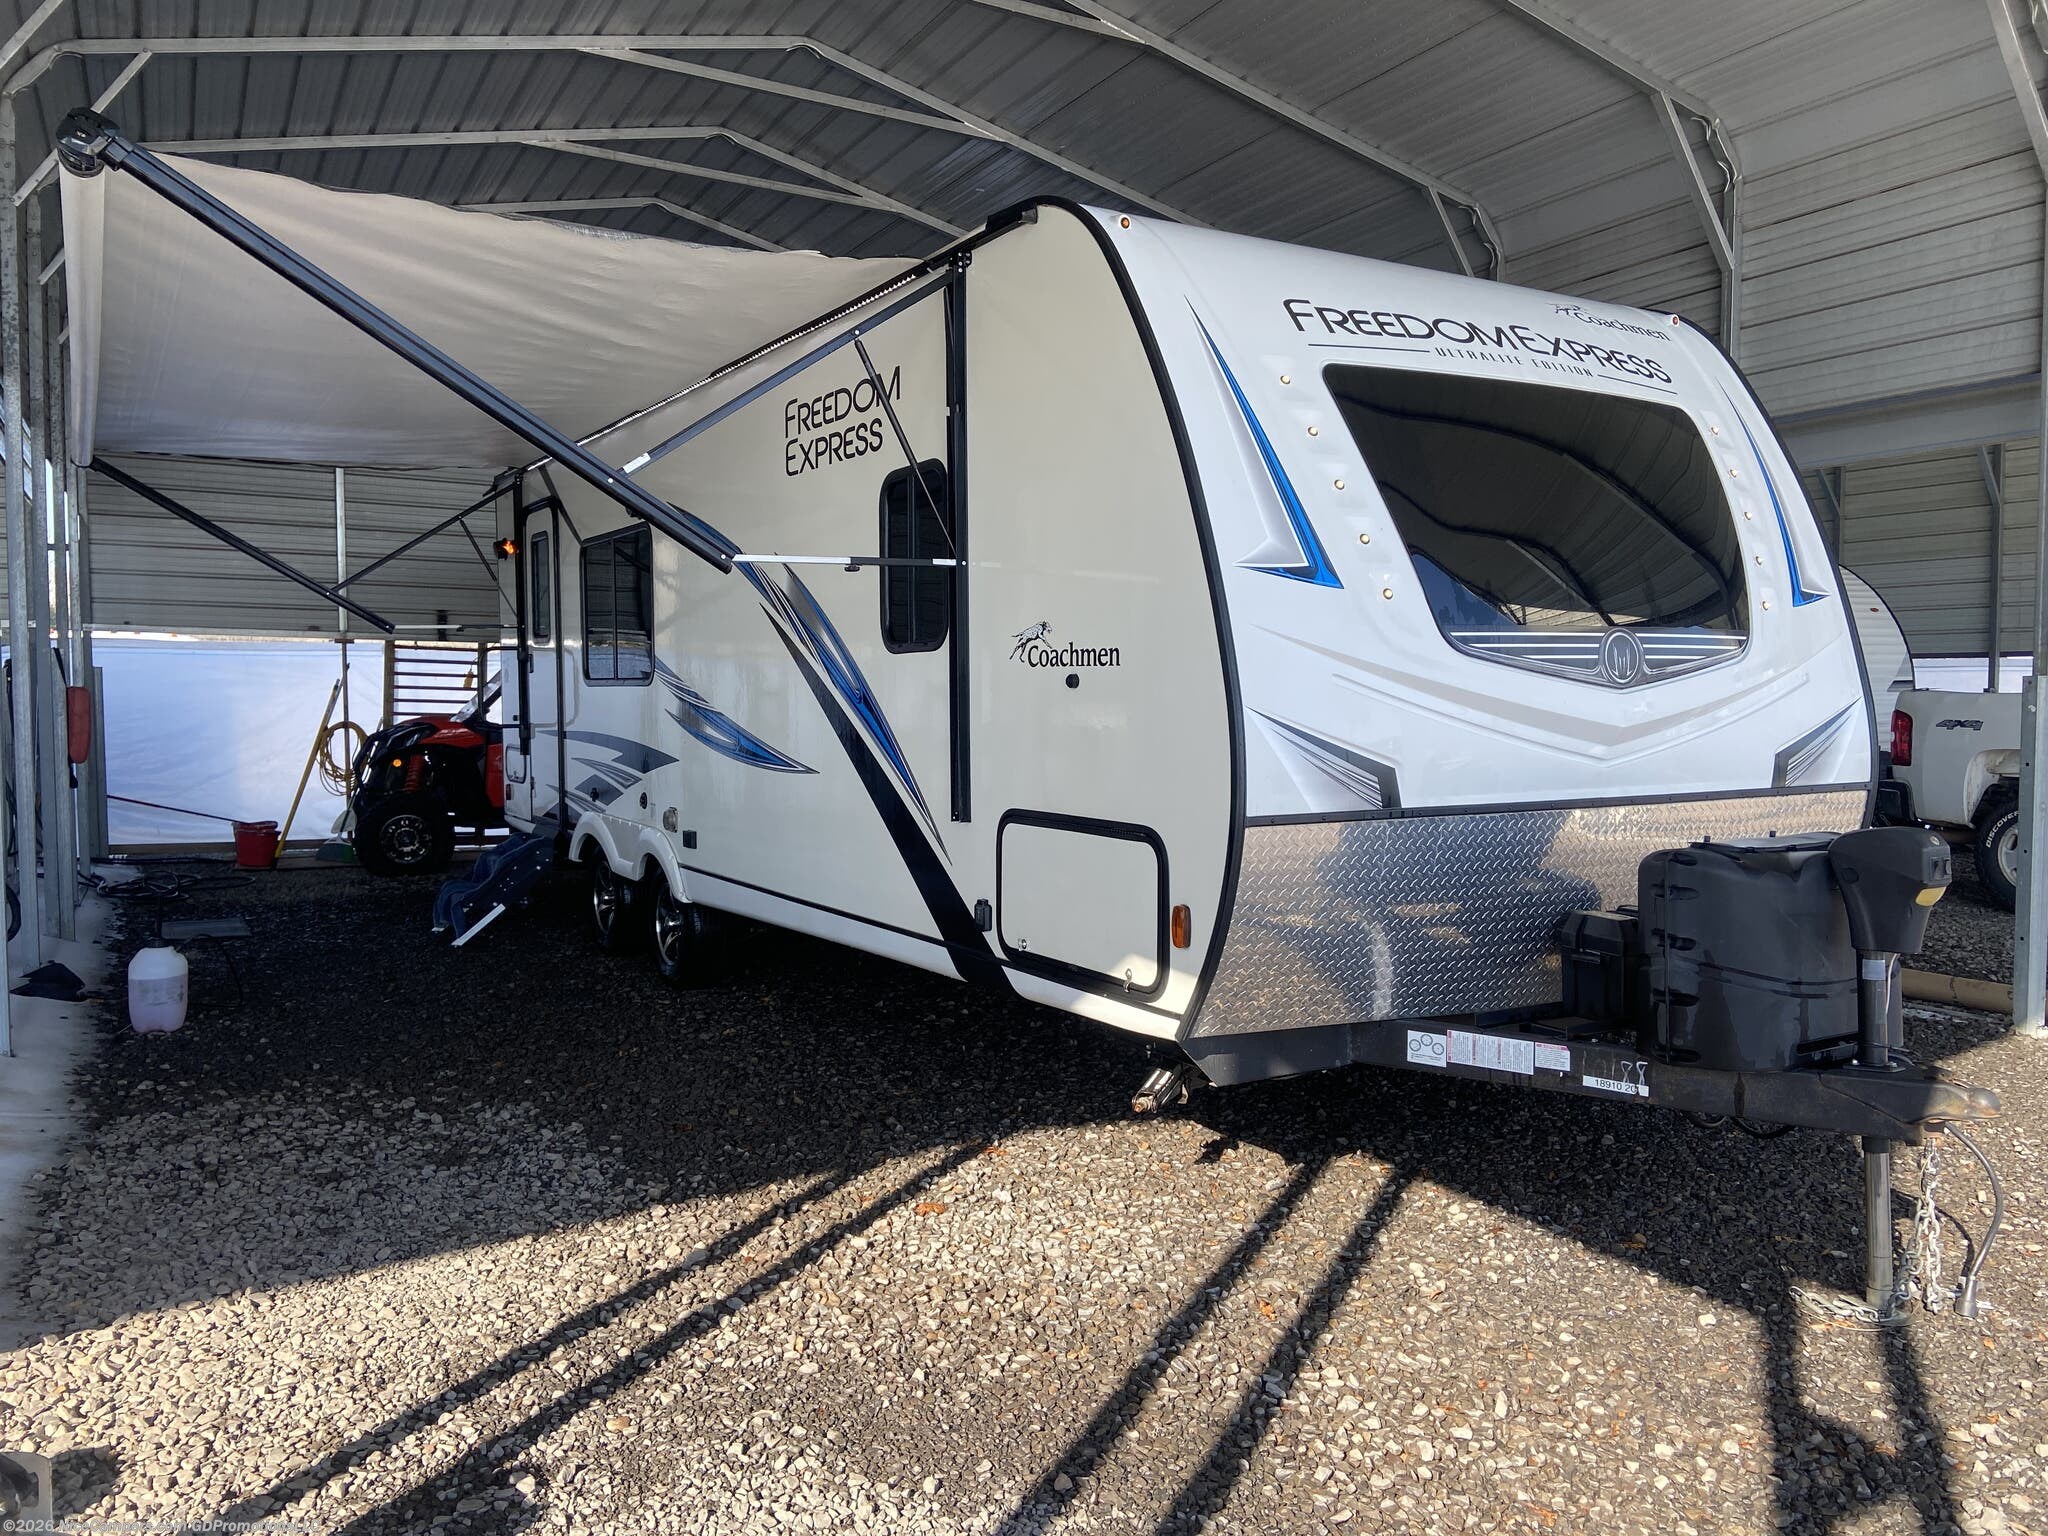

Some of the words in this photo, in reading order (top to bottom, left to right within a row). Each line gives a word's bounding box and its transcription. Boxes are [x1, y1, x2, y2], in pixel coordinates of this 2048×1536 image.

[1574, 310, 1671, 342] Coachmen
[1435, 347, 1523, 366] ULTRALITE
[1531, 359, 1594, 377] EDITION
[785, 365, 900, 439] FREEDOM
[785, 417, 884, 476] EXPRESS
[1027, 641, 1121, 668] Coachmen
[1595, 1079, 1622, 1091] 18910
